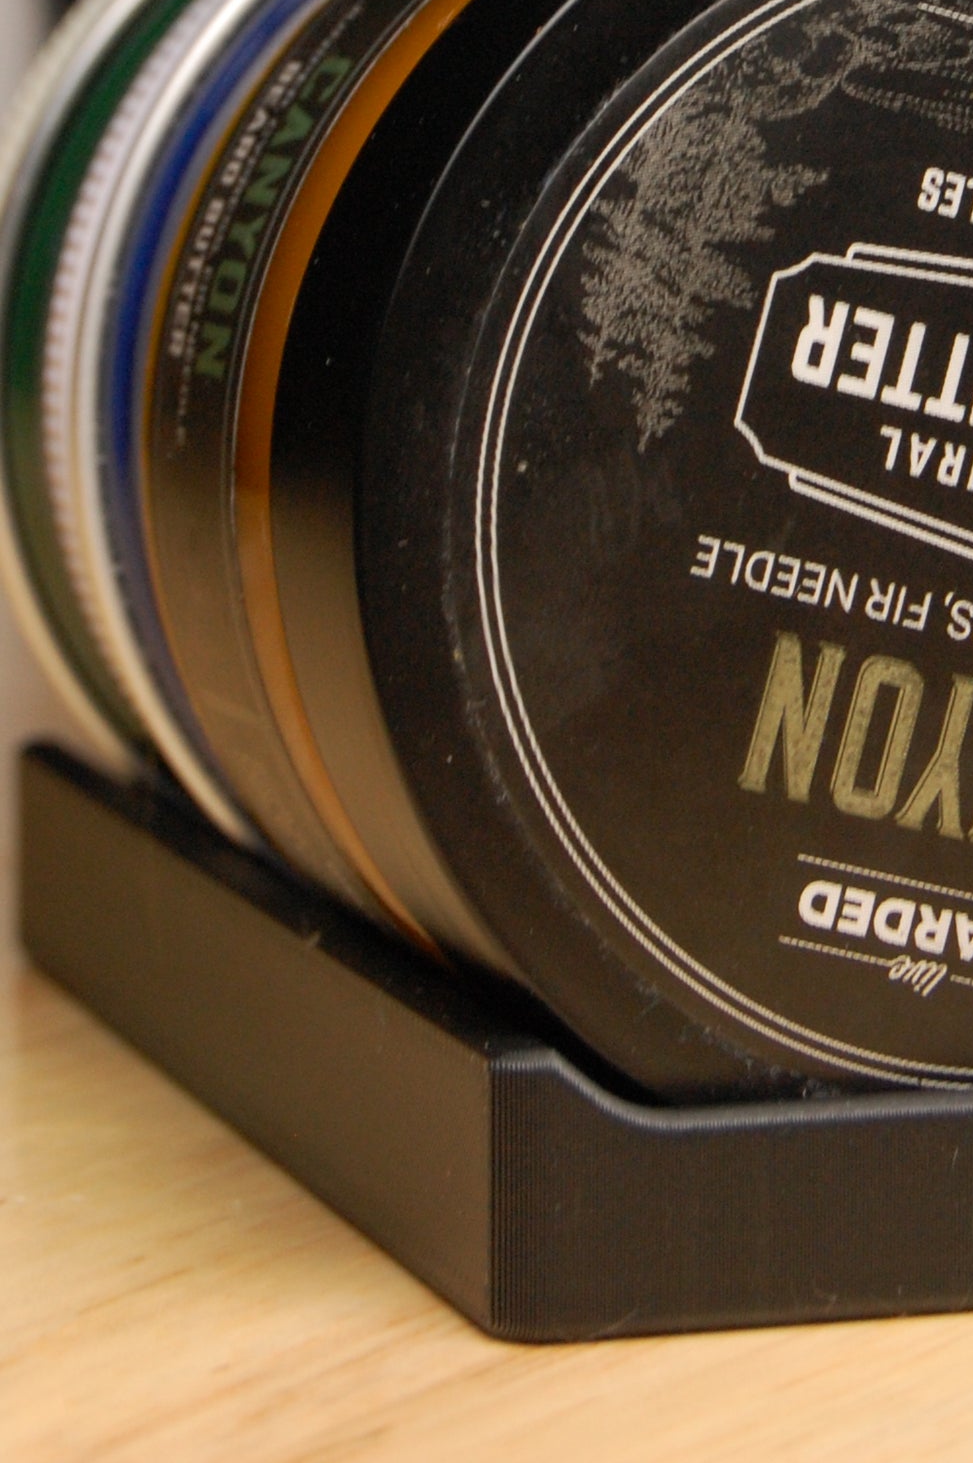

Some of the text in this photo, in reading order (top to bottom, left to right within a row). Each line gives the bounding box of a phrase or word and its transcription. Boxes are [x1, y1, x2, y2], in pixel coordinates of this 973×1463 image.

[168, 59, 301, 358] BEARD BUTTER
[196, 53, 353, 379] CANYON
[689, 534, 860, 613] NEEDLE
[865, 579, 933, 632] FIR
[889, 954, 950, 999] live
